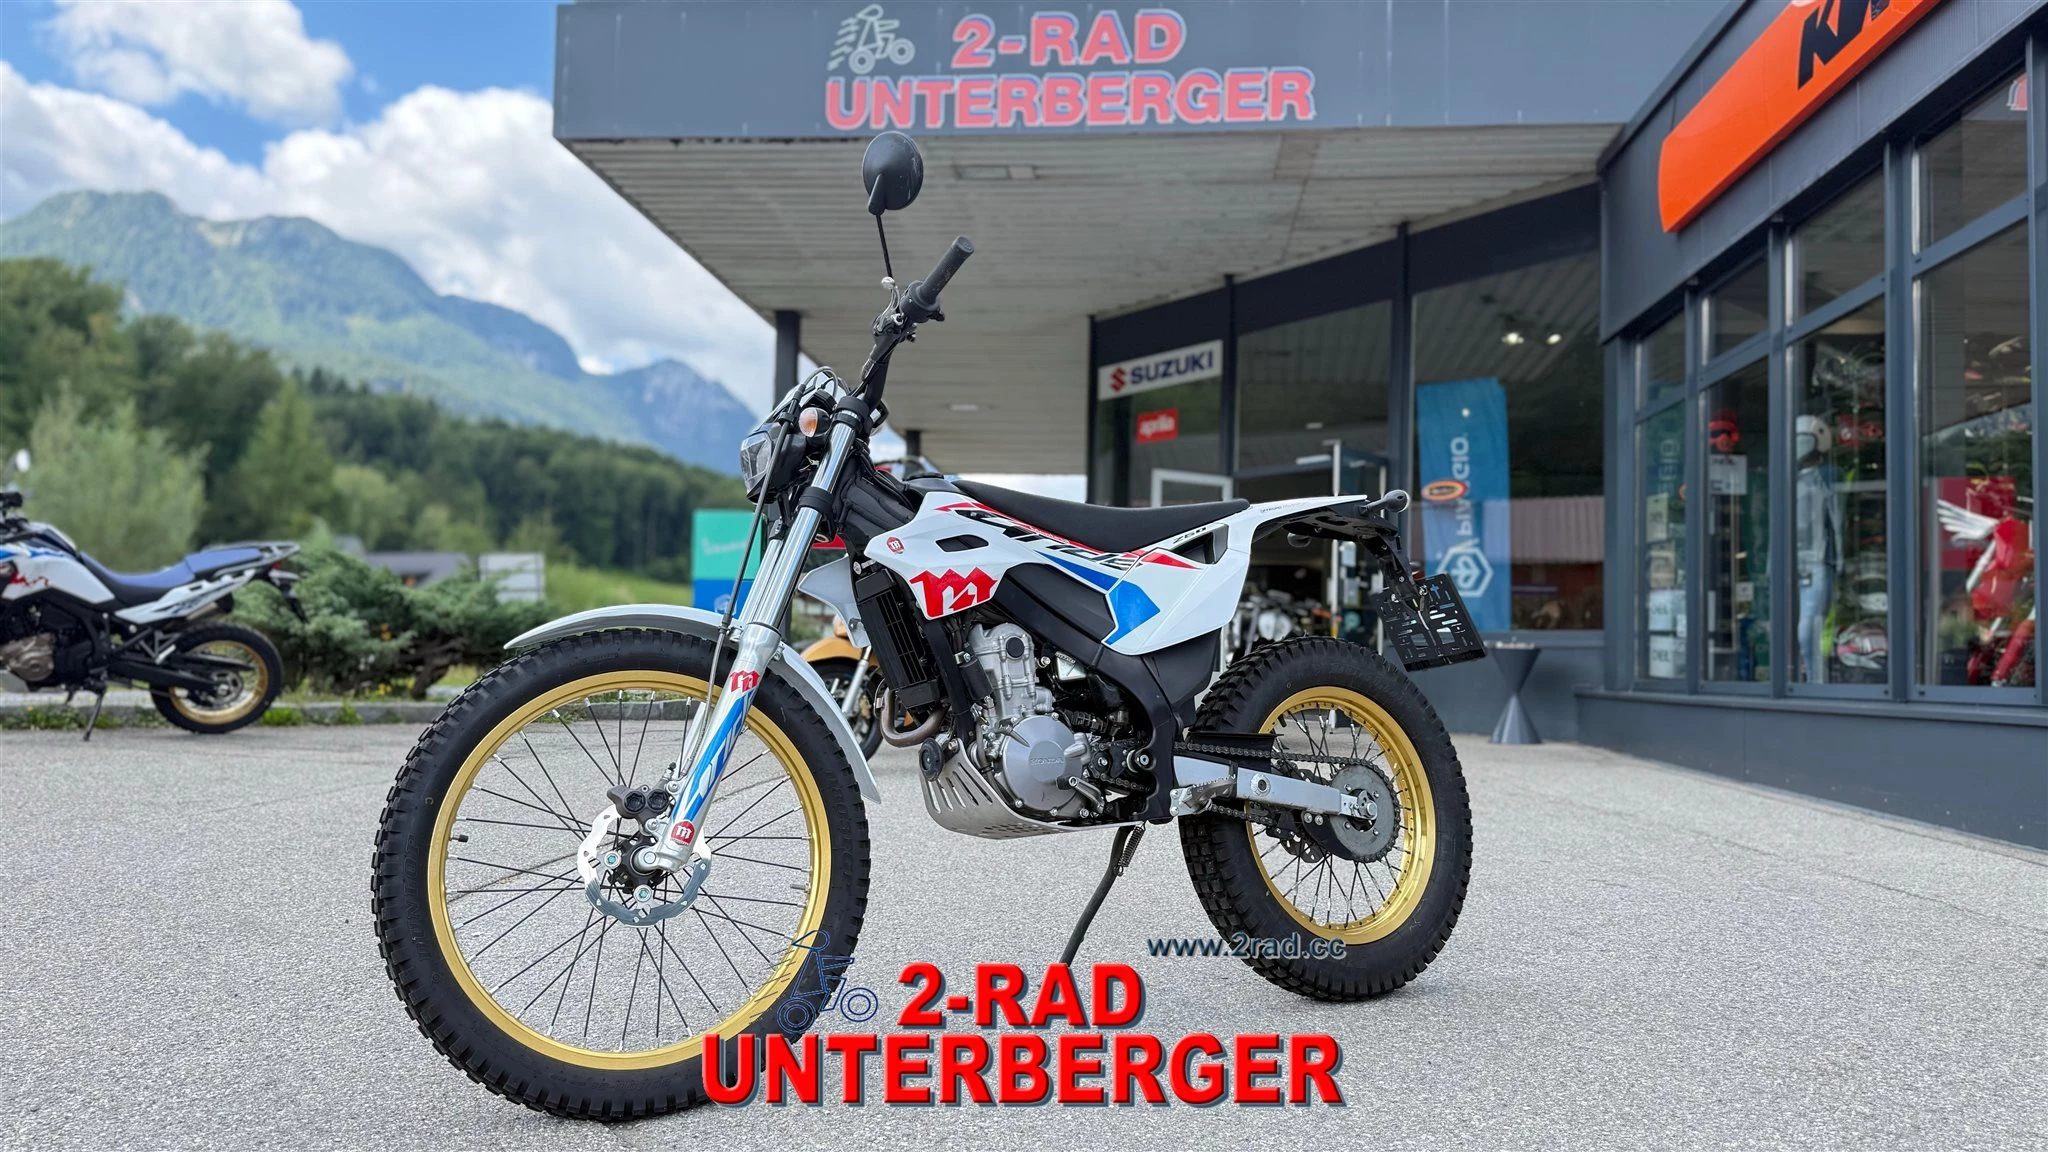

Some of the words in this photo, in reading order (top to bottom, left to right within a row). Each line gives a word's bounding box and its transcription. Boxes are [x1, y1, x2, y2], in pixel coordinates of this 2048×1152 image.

[952, 9, 1187, 67] 2-RAD
[826, 66, 1316, 130] UNTERBERGER
[1131, 351, 1214, 385] SUZUKI
